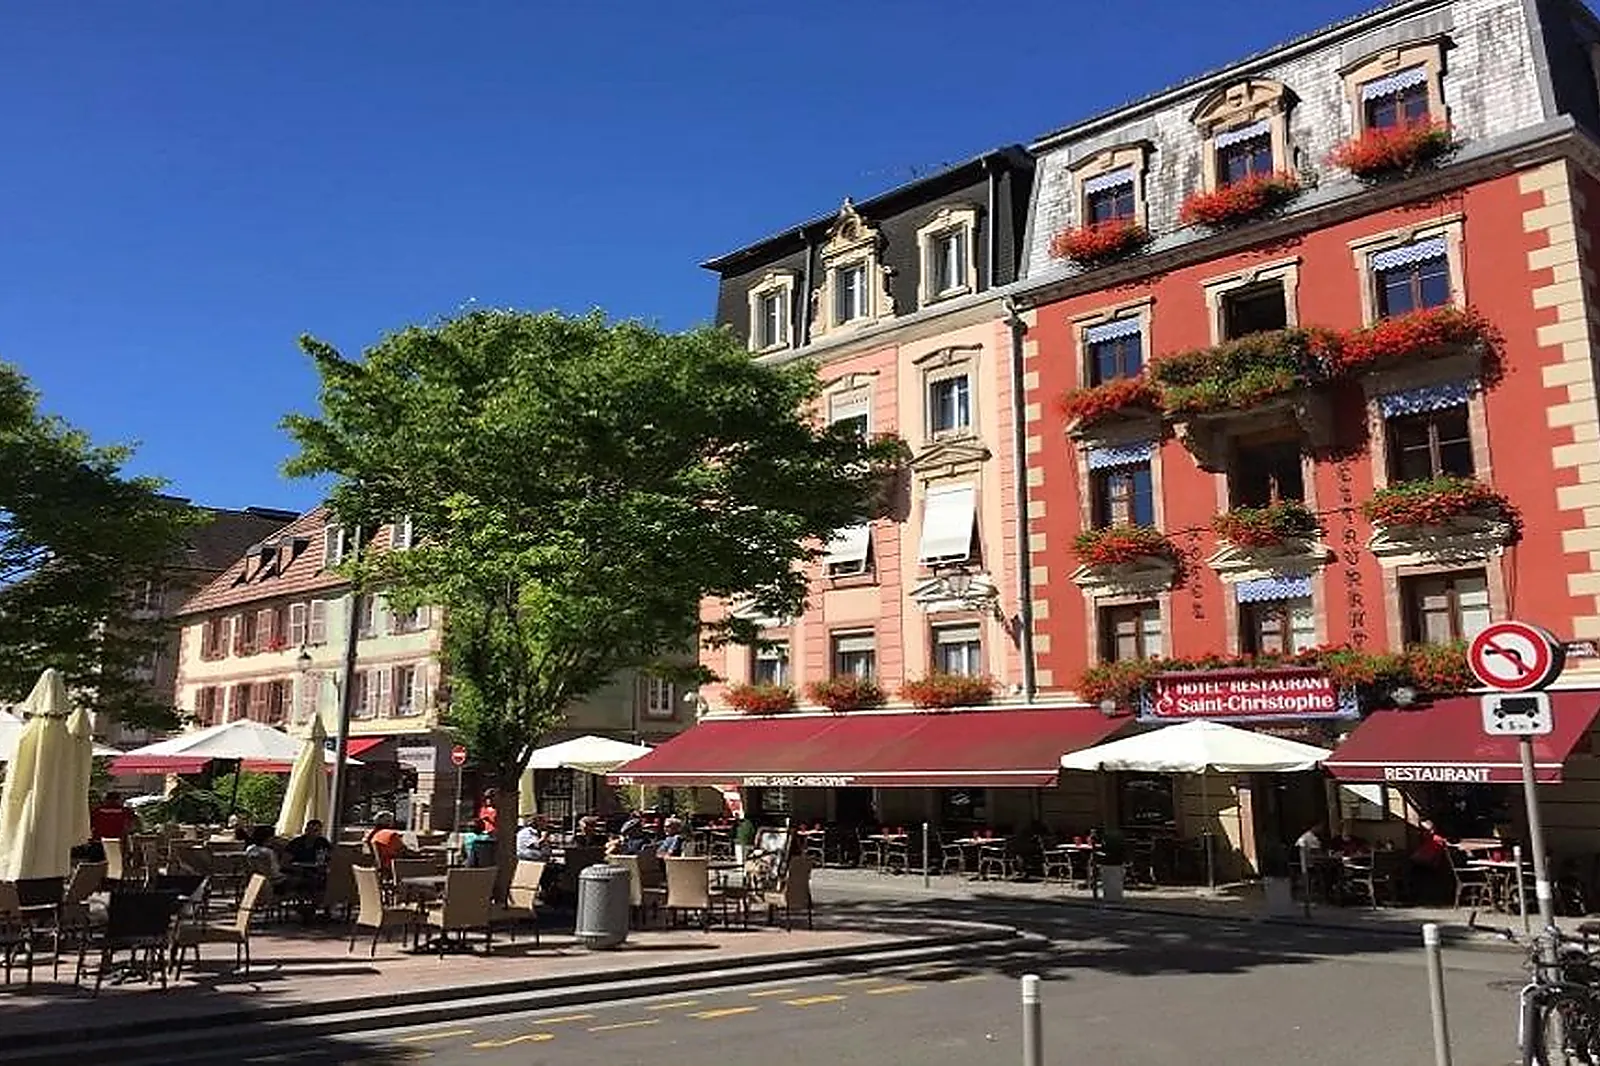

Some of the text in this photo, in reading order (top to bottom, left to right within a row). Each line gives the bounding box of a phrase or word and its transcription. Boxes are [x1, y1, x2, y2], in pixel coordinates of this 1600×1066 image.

[1176, 677, 1330, 696] HOTEL RESTAURANT
[1178, 692, 1333, 713] Saint-Christophe
[1384, 767, 1491, 782] RESTAURANT
